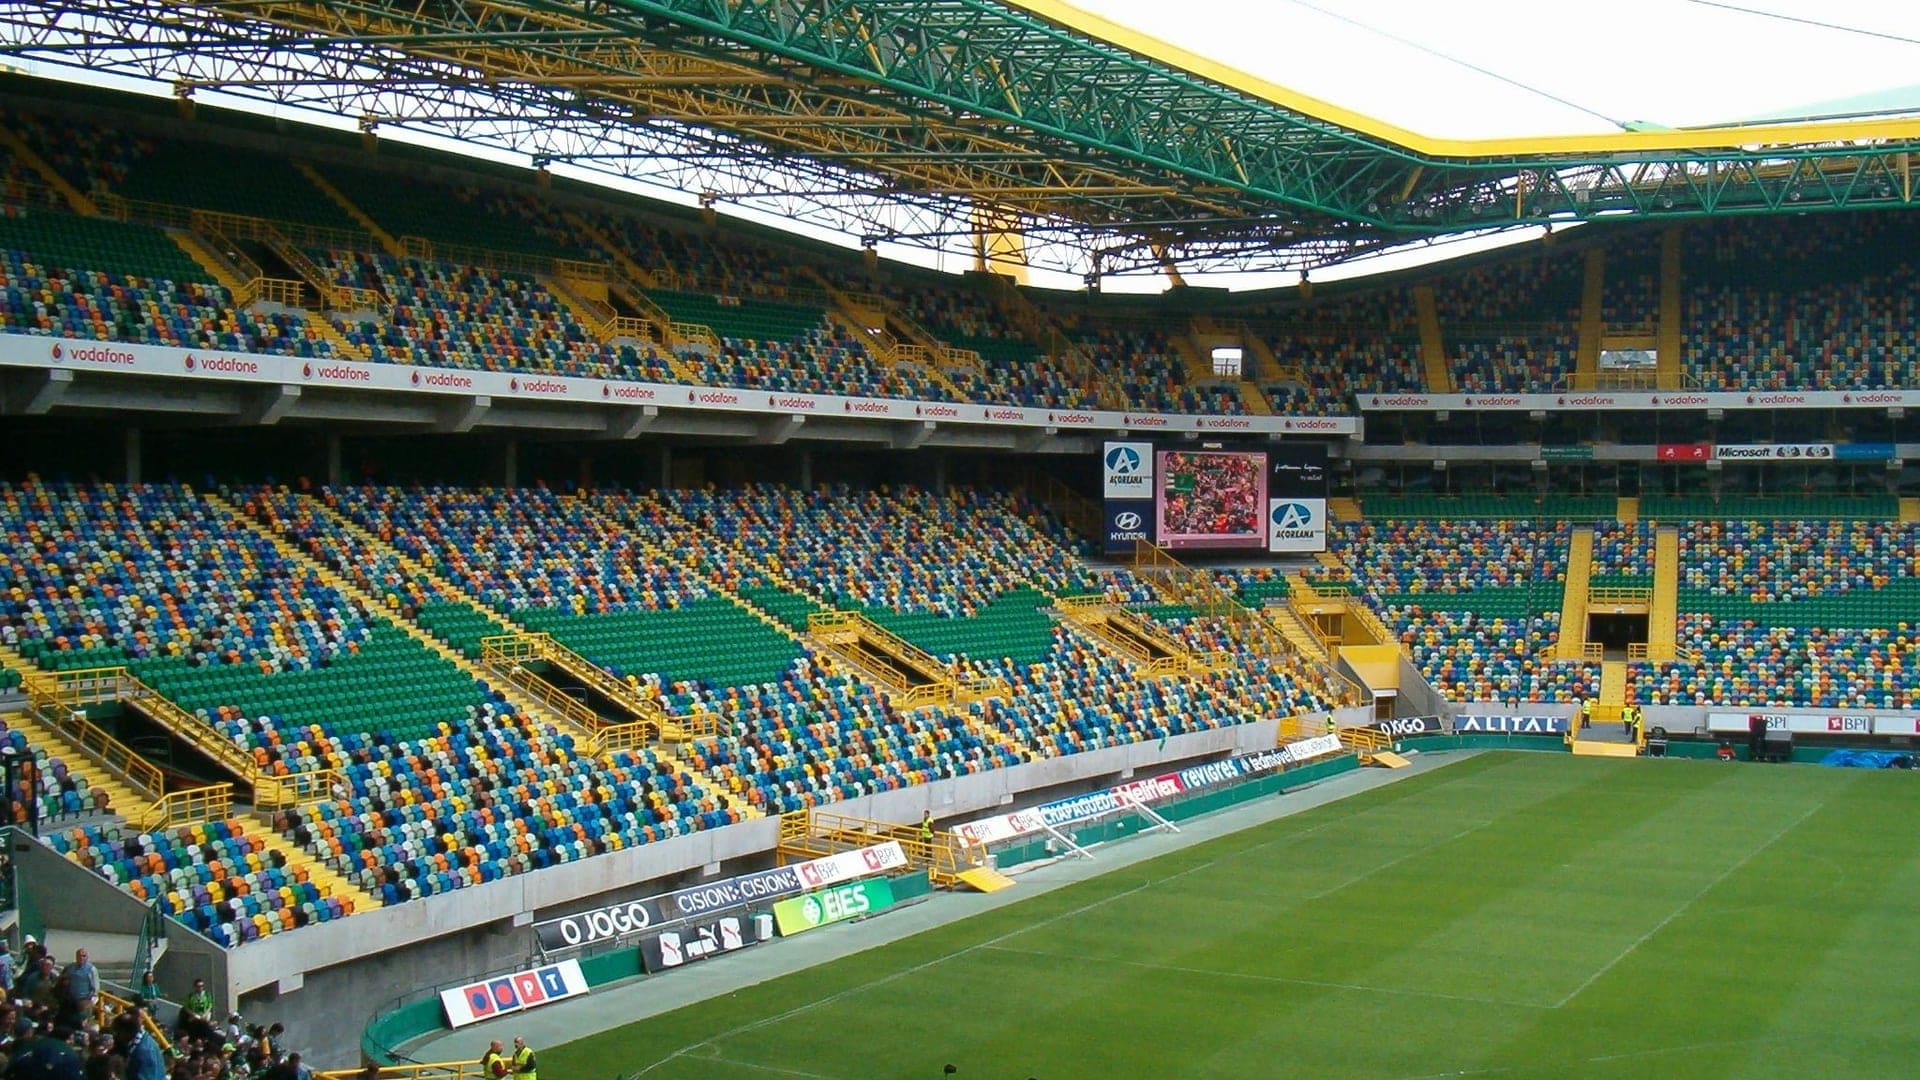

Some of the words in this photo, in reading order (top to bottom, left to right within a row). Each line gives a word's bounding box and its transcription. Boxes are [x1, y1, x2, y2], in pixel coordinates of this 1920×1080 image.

[70, 346, 134, 364] vodafone
[201, 355, 258, 374] vodafone
[317, 365, 370, 382] vodafone
[425, 373, 472, 389] vodafone
[523, 380, 567, 395] vodafone
[614, 386, 655, 401] vodafone
[699, 392, 738, 405] vodafone
[778, 397, 816, 410] vodafone
[1384, 397, 1428, 406] vodafone
[1477, 397, 1521, 406] vodafone
[1570, 396, 1614, 405] vodafone
[1663, 396, 1709, 405] vodafone
[1759, 395, 1804, 404] vodafone
[1856, 394, 1902, 403] vodafone
[854, 401, 889, 413] vodafone
[924, 406, 958, 417] vodafone
[992, 409, 1024, 420] vodafone
[1057, 413, 1094, 424] vodafone
[1132, 416, 1168, 426] vodafone
[1208, 418, 1249, 428] vodafone
[1295, 420, 1337, 429] vodafone
[1718, 447, 1770, 457] Microsoft
[1766, 716, 1786, 729] BPI
[1844, 717, 1867, 730] BPI
[876, 847, 898, 865] BPI
[816, 861, 840, 880] BPI
[560, 919, 582, 945] O
[583, 903, 650, 941] JOGO
